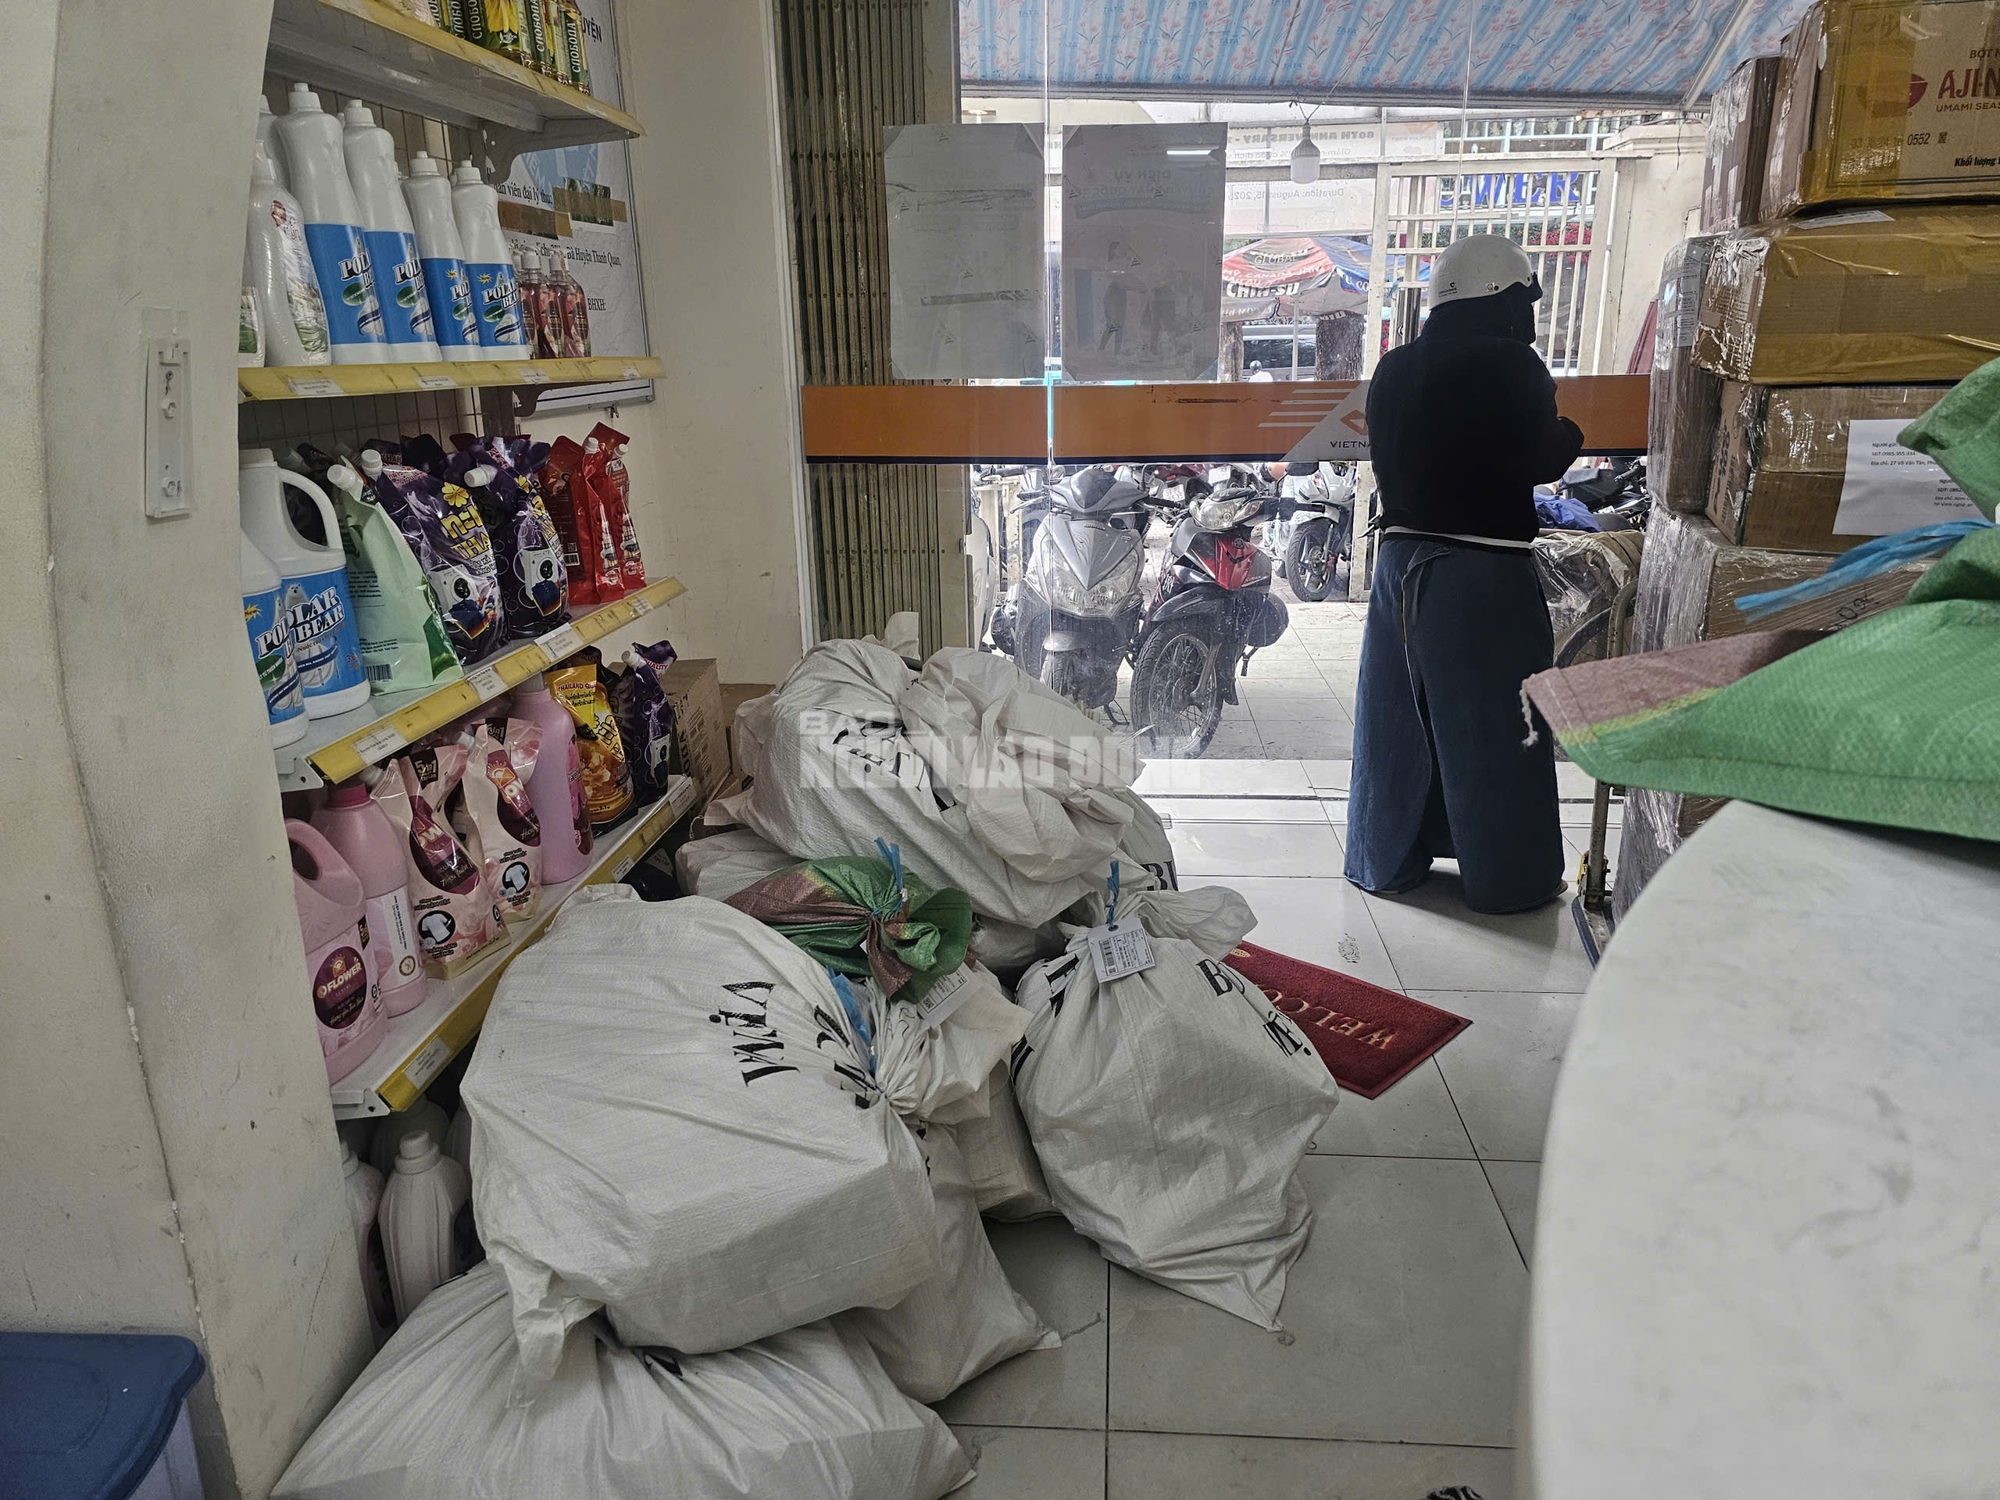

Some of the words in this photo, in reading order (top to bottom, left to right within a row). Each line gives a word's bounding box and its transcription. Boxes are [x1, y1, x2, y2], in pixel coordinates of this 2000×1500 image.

[468, 0, 483, 39] СЛОБО
[1936, 103, 1973, 113] UMAMI
[1975, 101, 2000, 111] SEAS
[1907, 132, 1930, 146] 0552
[1226, 281, 1300, 298] CHIN-SU
[296, 604, 344, 643] BEAR
[327, 961, 363, 992] FLOWER
[1264, 988, 1398, 1050] WELCO
